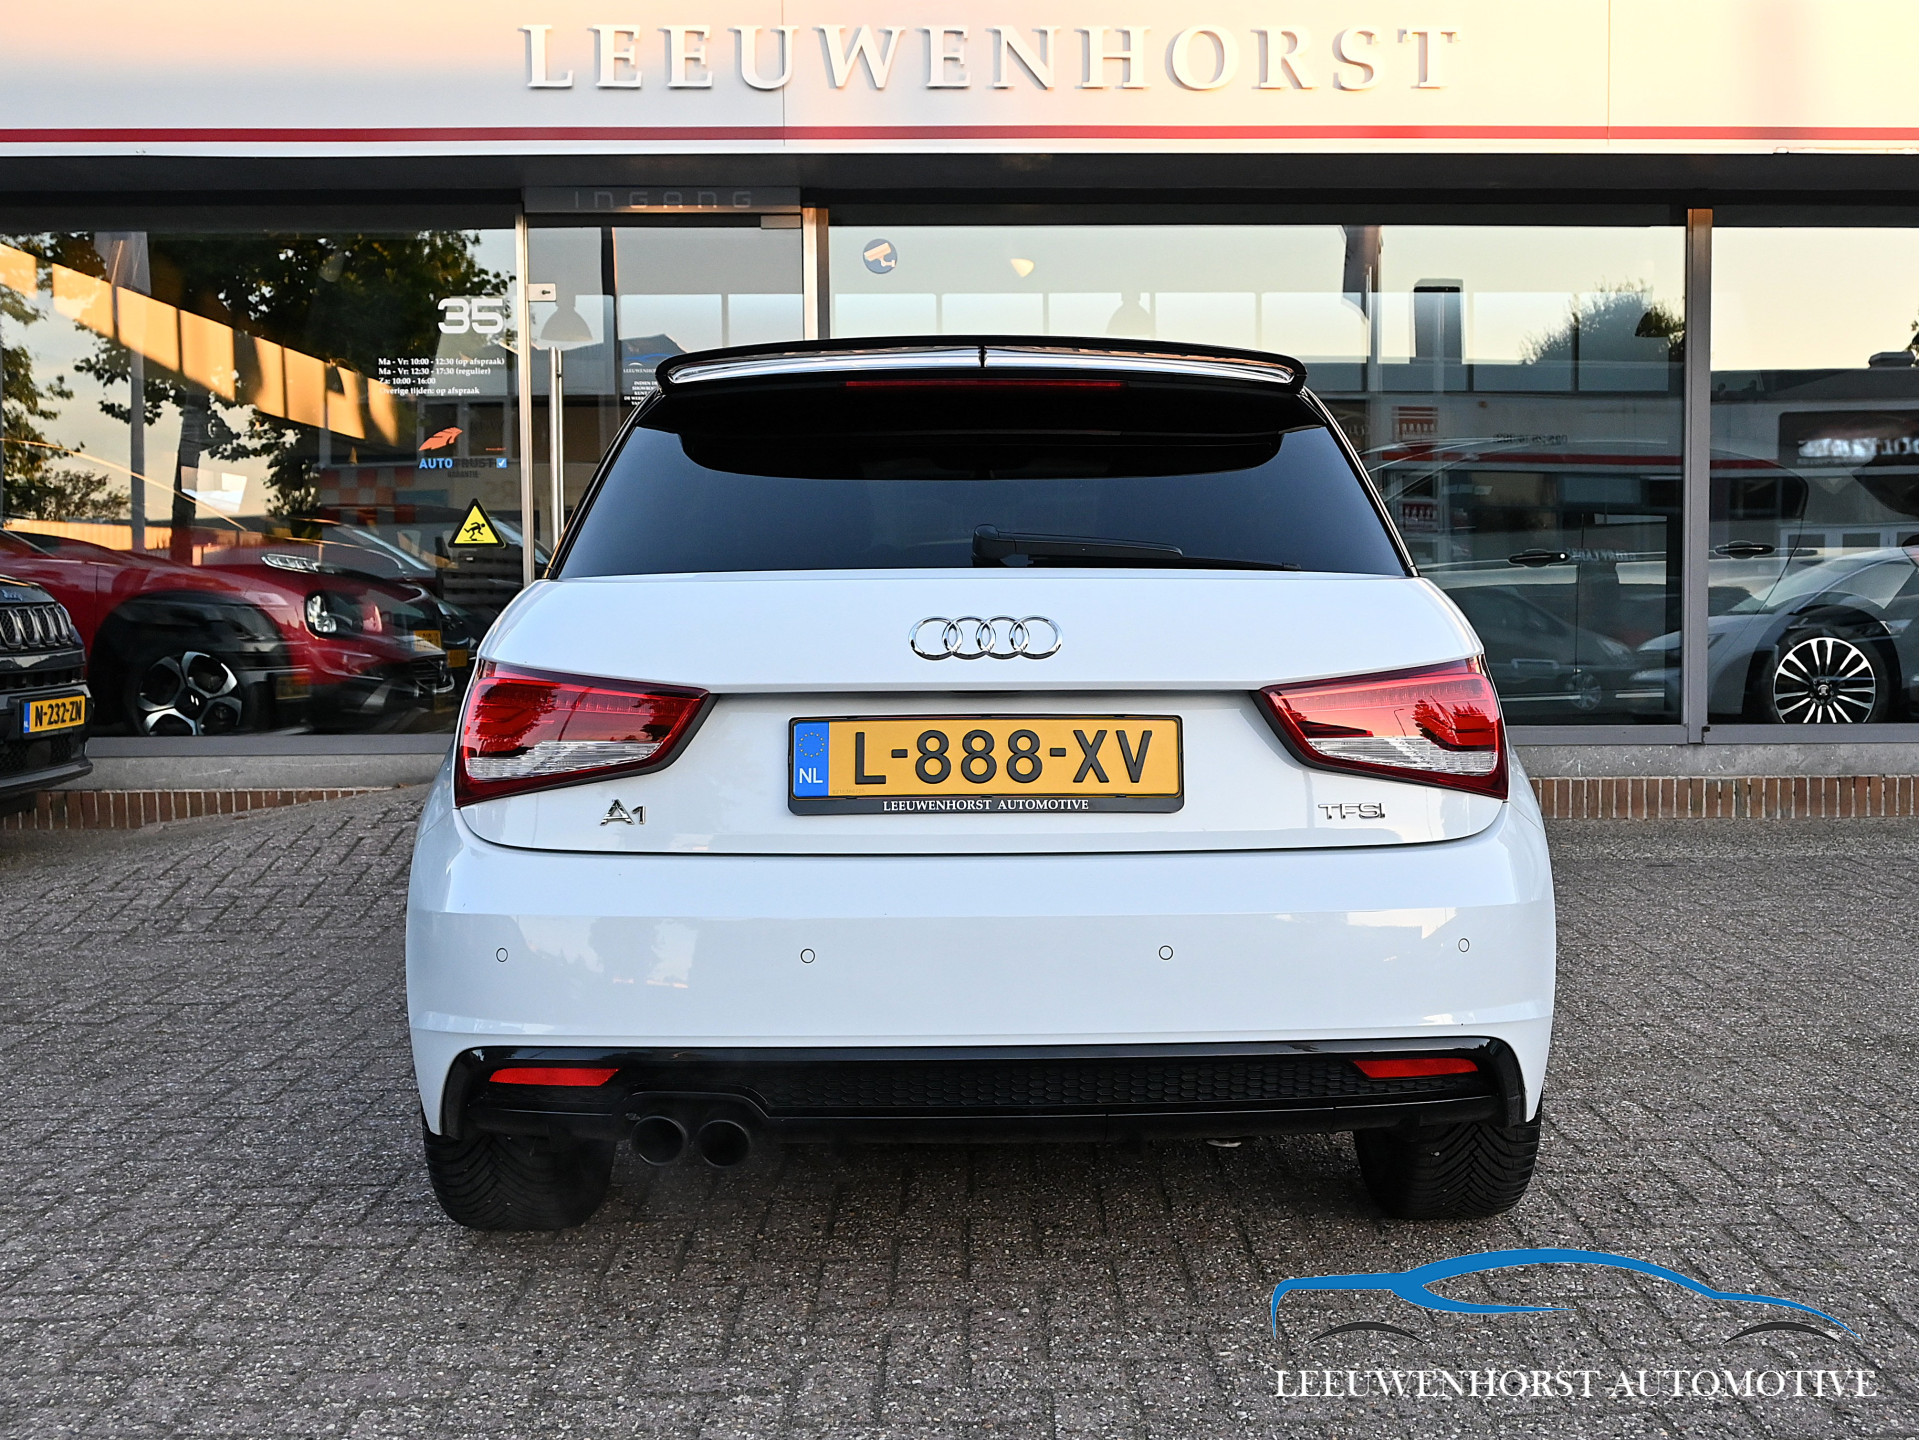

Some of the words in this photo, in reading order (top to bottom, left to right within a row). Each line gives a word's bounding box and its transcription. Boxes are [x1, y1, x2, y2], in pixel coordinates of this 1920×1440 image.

[516, 23, 1460, 92] LEEUWENHORST
[437, 298, 504, 334] 35
[378, 357, 391, 366] Ma
[410, 357, 430, 366] 10:00
[436, 357, 455, 366] 12:30
[455, 357, 468, 367] (op
[470, 357, 505, 367] afspraak)
[378, 367, 391, 375] Ma
[411, 367, 430, 375] 12:30
[436, 367, 455, 375] 17:30
[455, 367, 491, 377] (regulier)
[392, 377, 412, 385] 10:00
[417, 377, 436, 385] 16:00
[410, 386, 435, 396] tijden:
[435, 388, 446, 396] op
[447, 386, 480, 396] afspraak
[34, 699, 83, 728] N-232-ZN
[854, 729, 1153, 785] L-888-XV
[798, 766, 824, 784] NL
[600, 799, 646, 826] A1
[883, 799, 992, 812] LEEUWENHORST
[997, 799, 1089, 811] AUTOMOTIVE
[1317, 802, 1385, 820] TFSI
